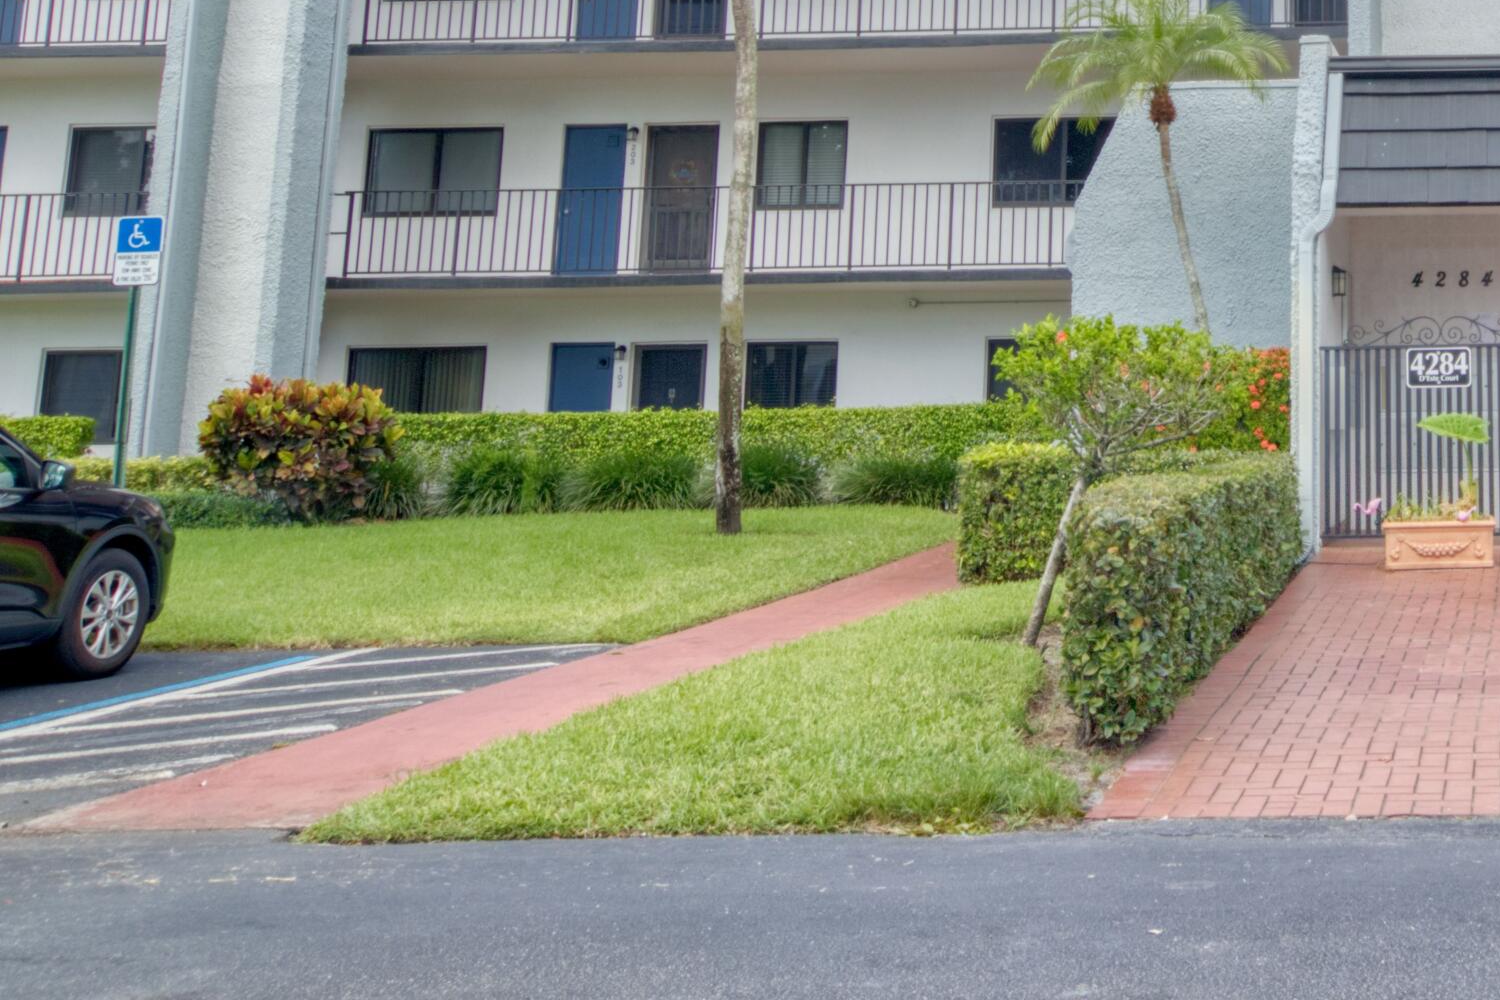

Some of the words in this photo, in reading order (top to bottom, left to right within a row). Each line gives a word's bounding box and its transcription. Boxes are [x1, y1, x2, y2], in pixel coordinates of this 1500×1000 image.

[1411, 270, 1494, 288] 4284
[1410, 352, 1469, 376] 4284
[1440, 374, 1459, 382] Court
